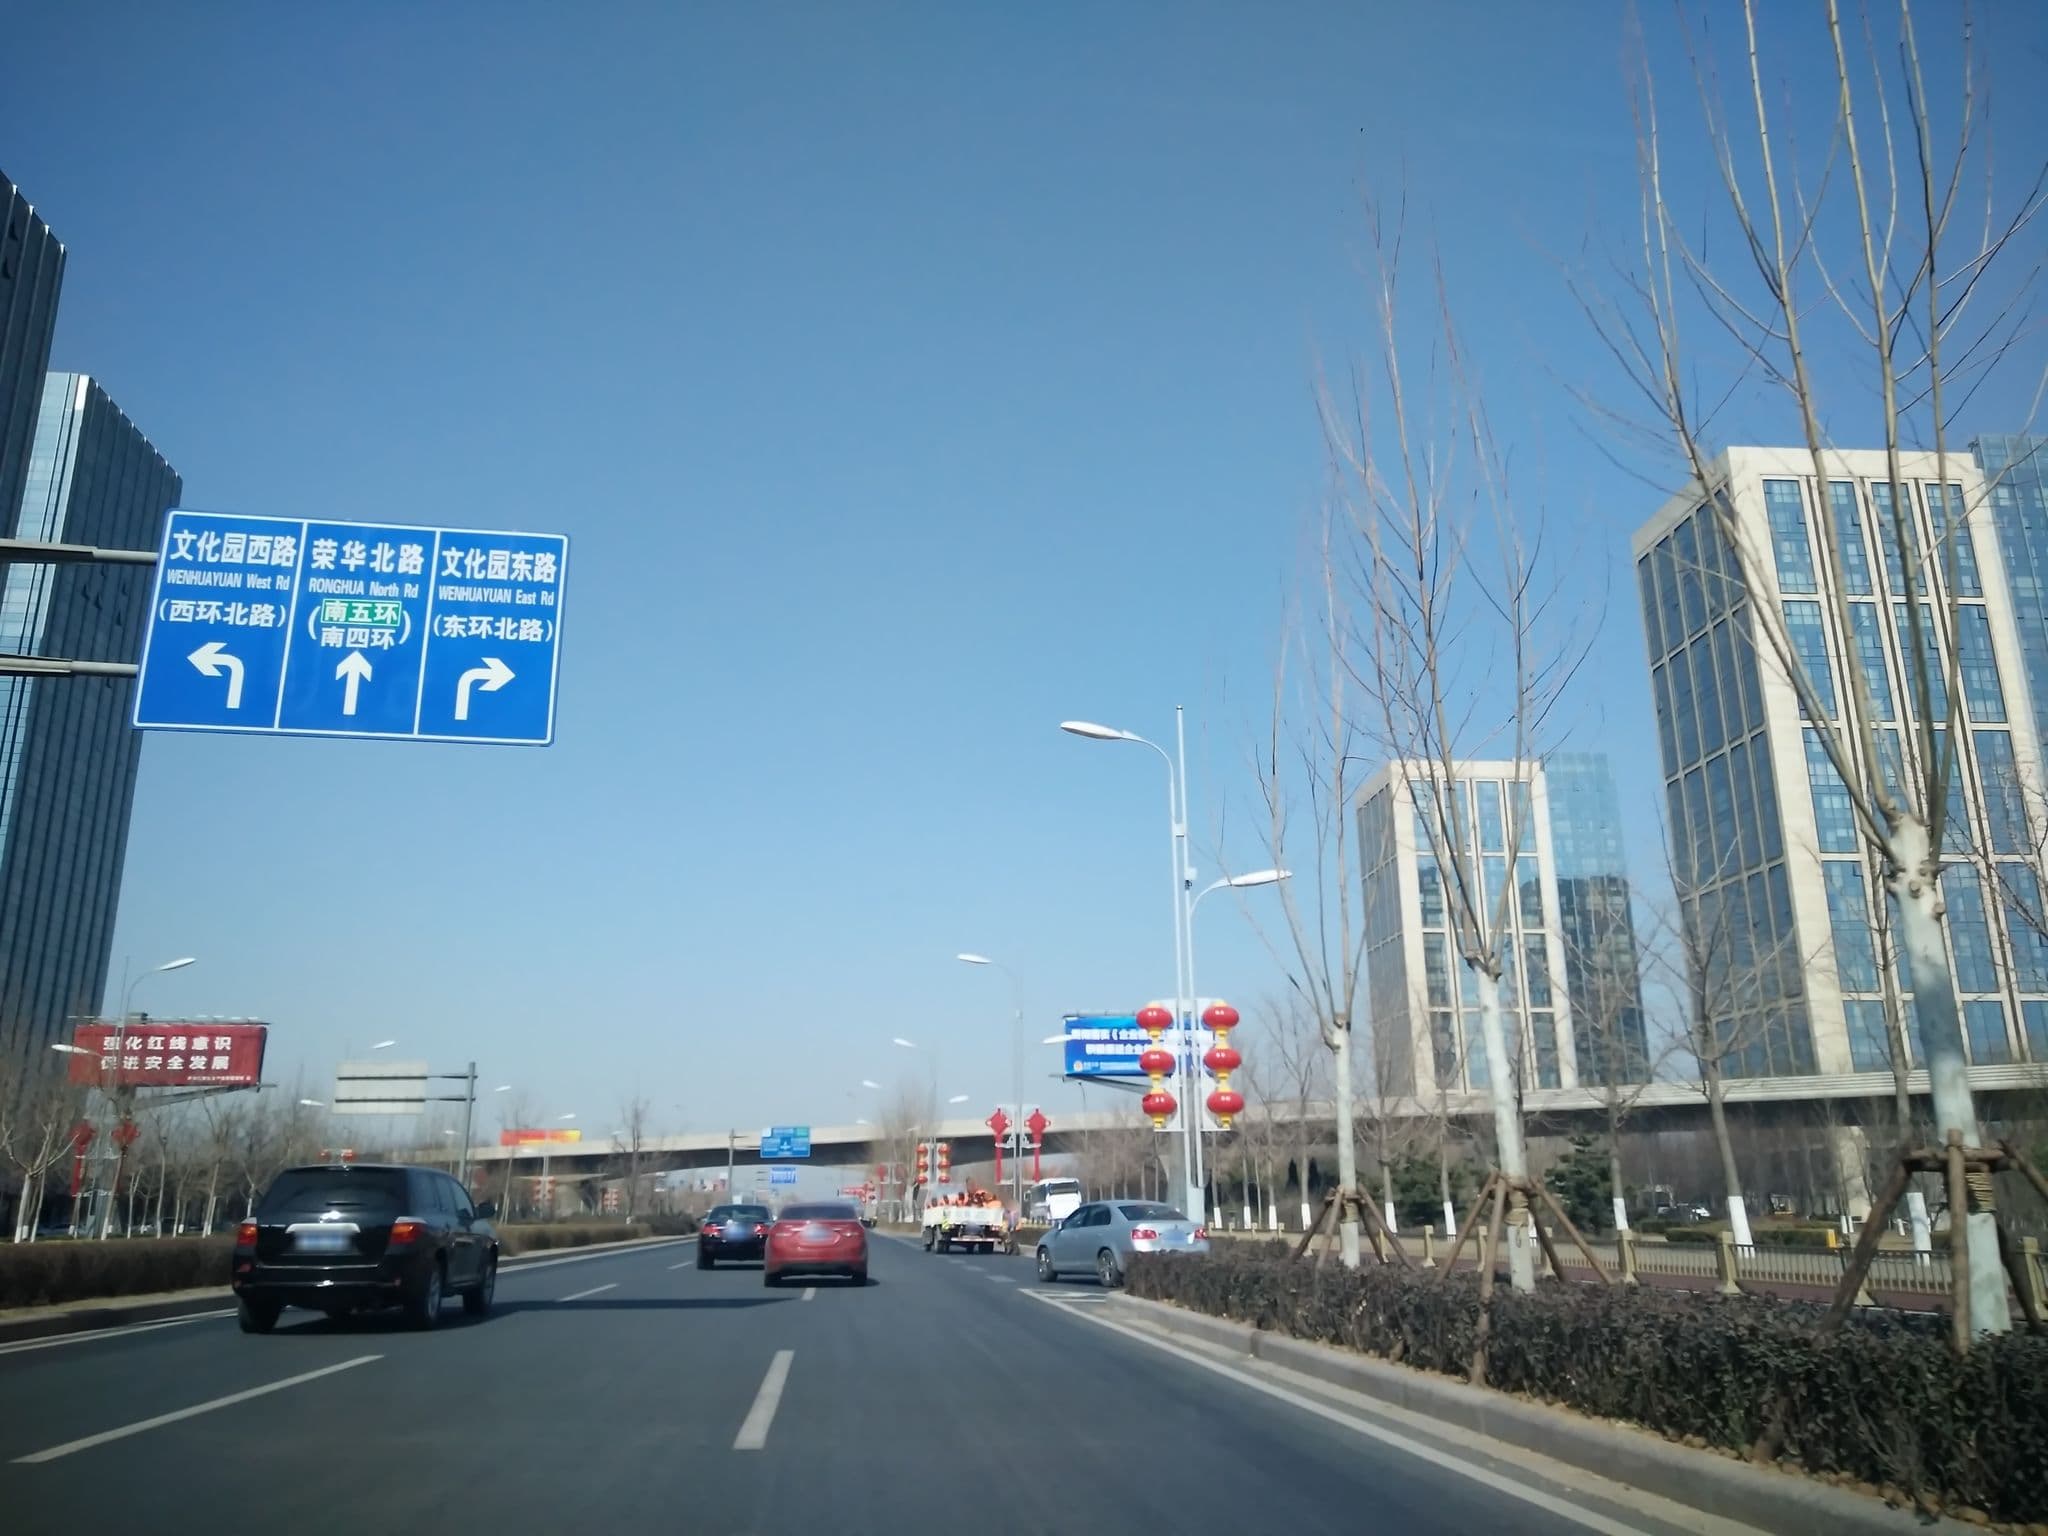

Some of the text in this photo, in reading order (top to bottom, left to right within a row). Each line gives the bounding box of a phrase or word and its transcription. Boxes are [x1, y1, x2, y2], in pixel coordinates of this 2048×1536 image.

[170, 529, 297, 567] 文化园西路
[311, 538, 424, 575] 荣华北路
[441, 547, 557, 583] 文化园东路
[167, 569, 291, 590] WENHUAYUAN West Rd
[309, 577, 419, 598] RONGHUA North Rd
[439, 585, 555, 606] WENHUAYUAN East Rd
[324, 600, 399, 624] 南五环
[320, 626, 396, 650] 南四环
